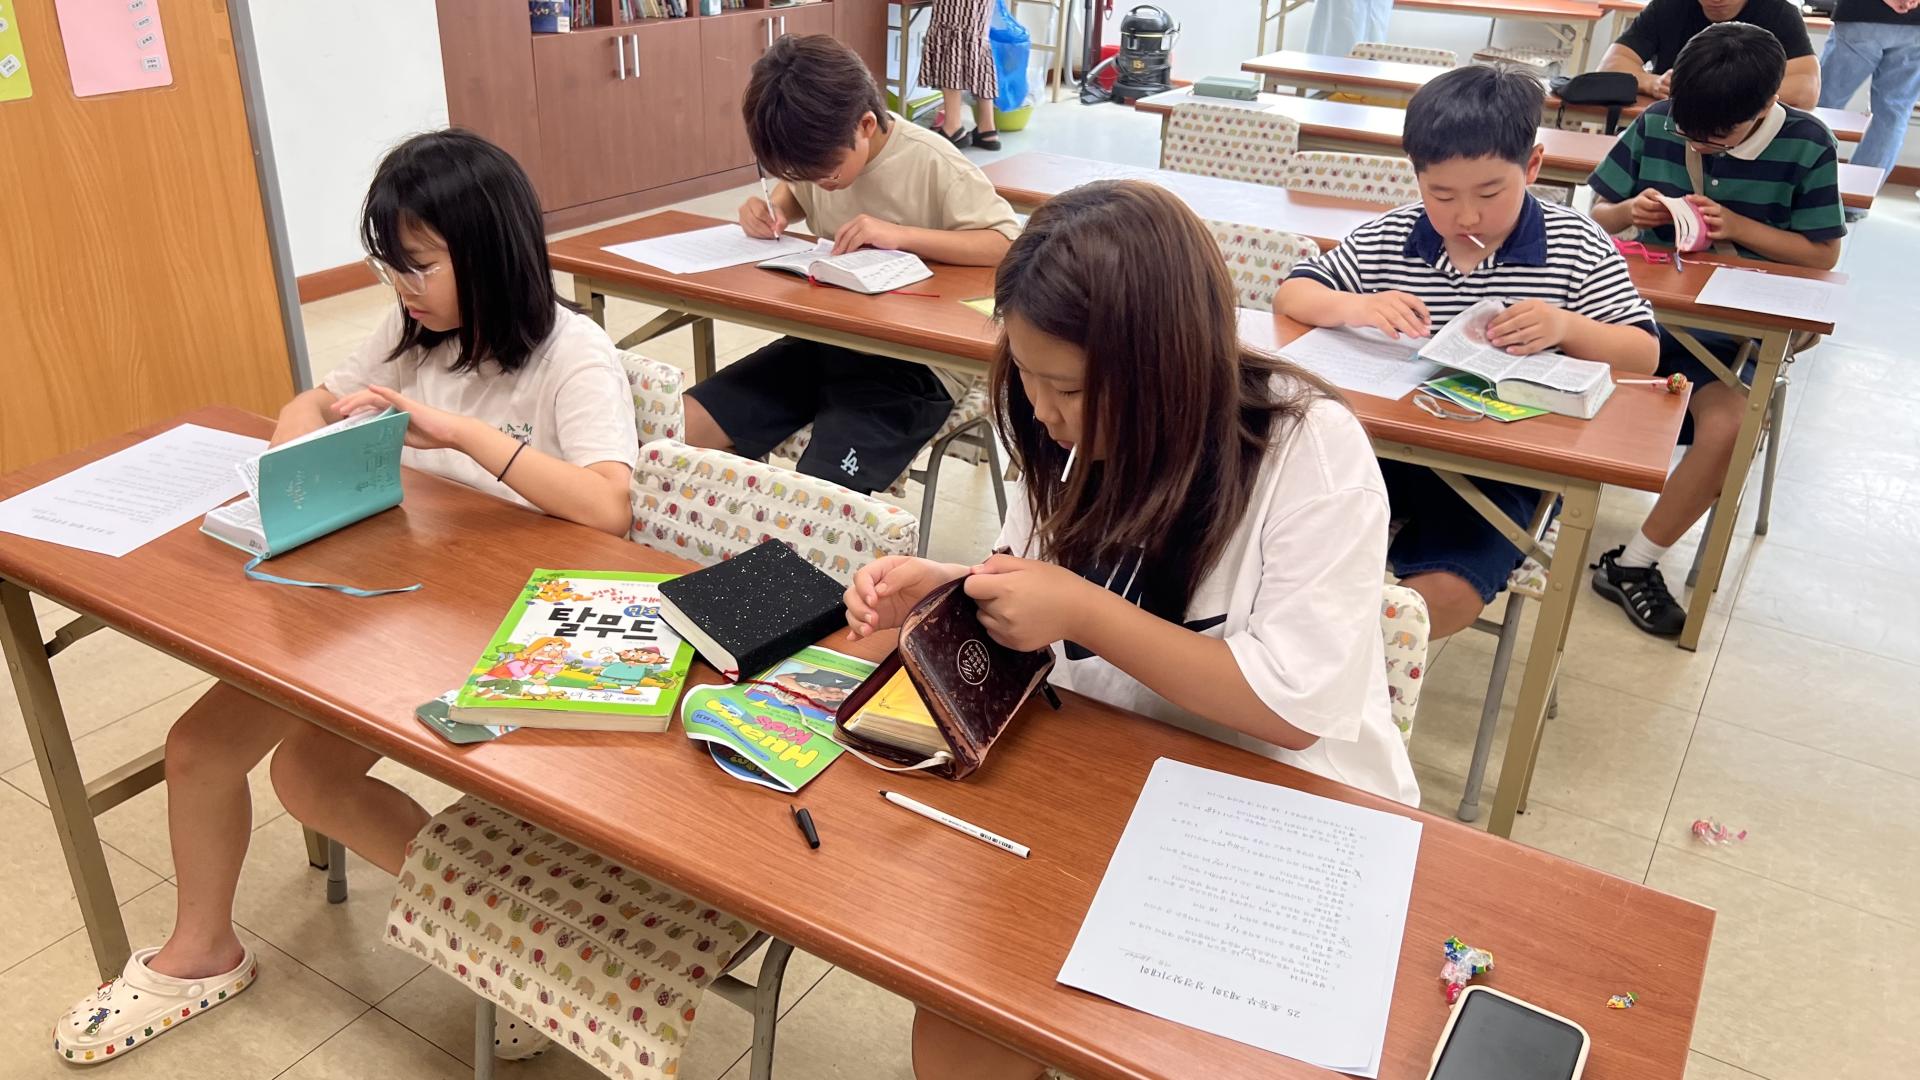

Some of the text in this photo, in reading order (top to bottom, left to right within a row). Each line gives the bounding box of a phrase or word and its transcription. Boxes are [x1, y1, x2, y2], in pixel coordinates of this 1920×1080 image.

[840, 447, 859, 476] LA
[548, 607, 658, 641] 탈무드
[754, 715, 813, 745] Kids
[1140, 965, 1301, 1018] 25 초등부 제3회 성경찾기대회
